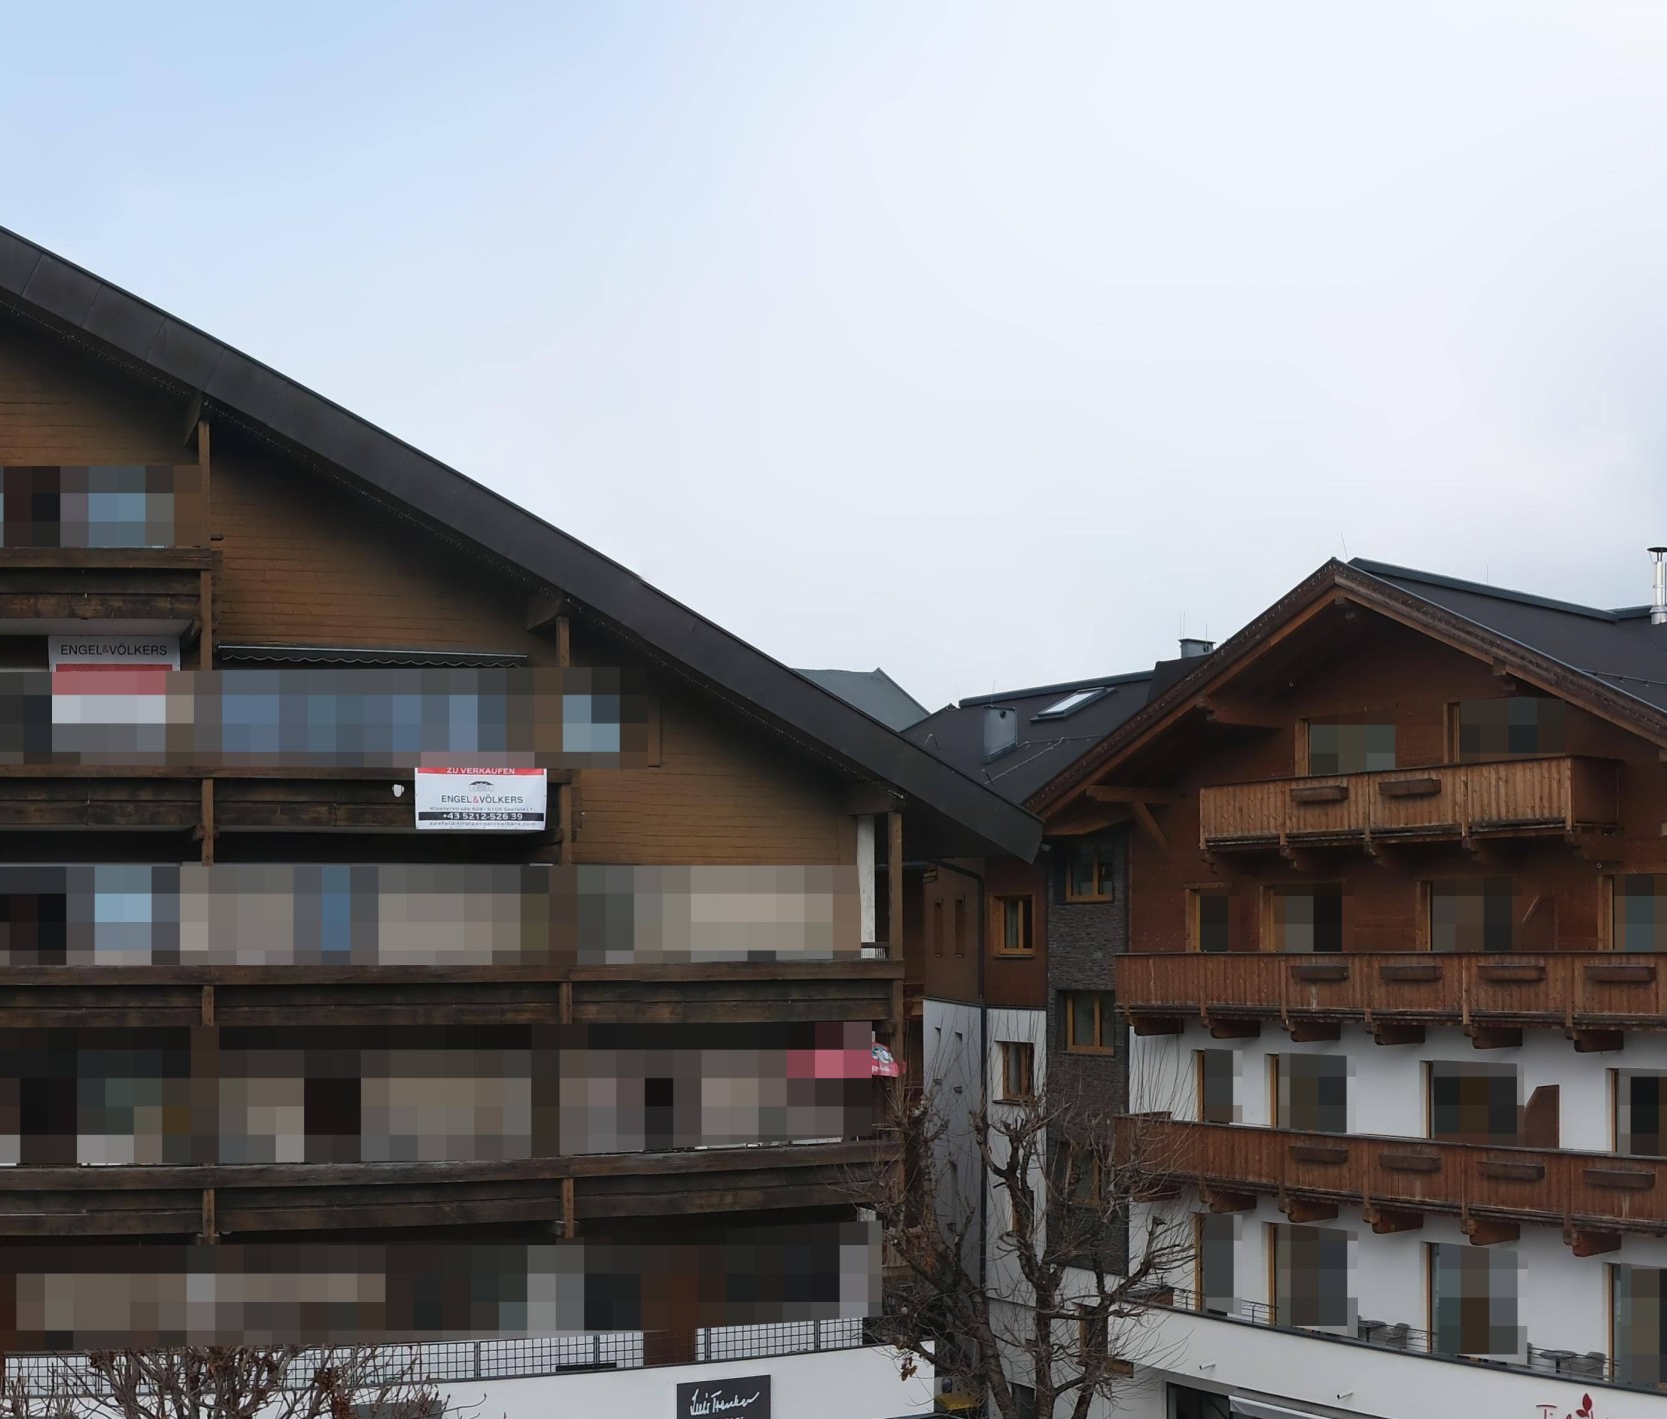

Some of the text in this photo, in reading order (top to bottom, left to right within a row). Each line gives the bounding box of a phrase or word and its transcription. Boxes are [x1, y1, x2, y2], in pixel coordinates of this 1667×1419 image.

[60, 643, 167, 655] ENGEL&VÖLKERS
[461, 767, 515, 775] VERKAUFEN
[441, 794, 524, 804] ENGEL&VÖLKERS
[442, 812, 523, 820] +43 5212-526 39
